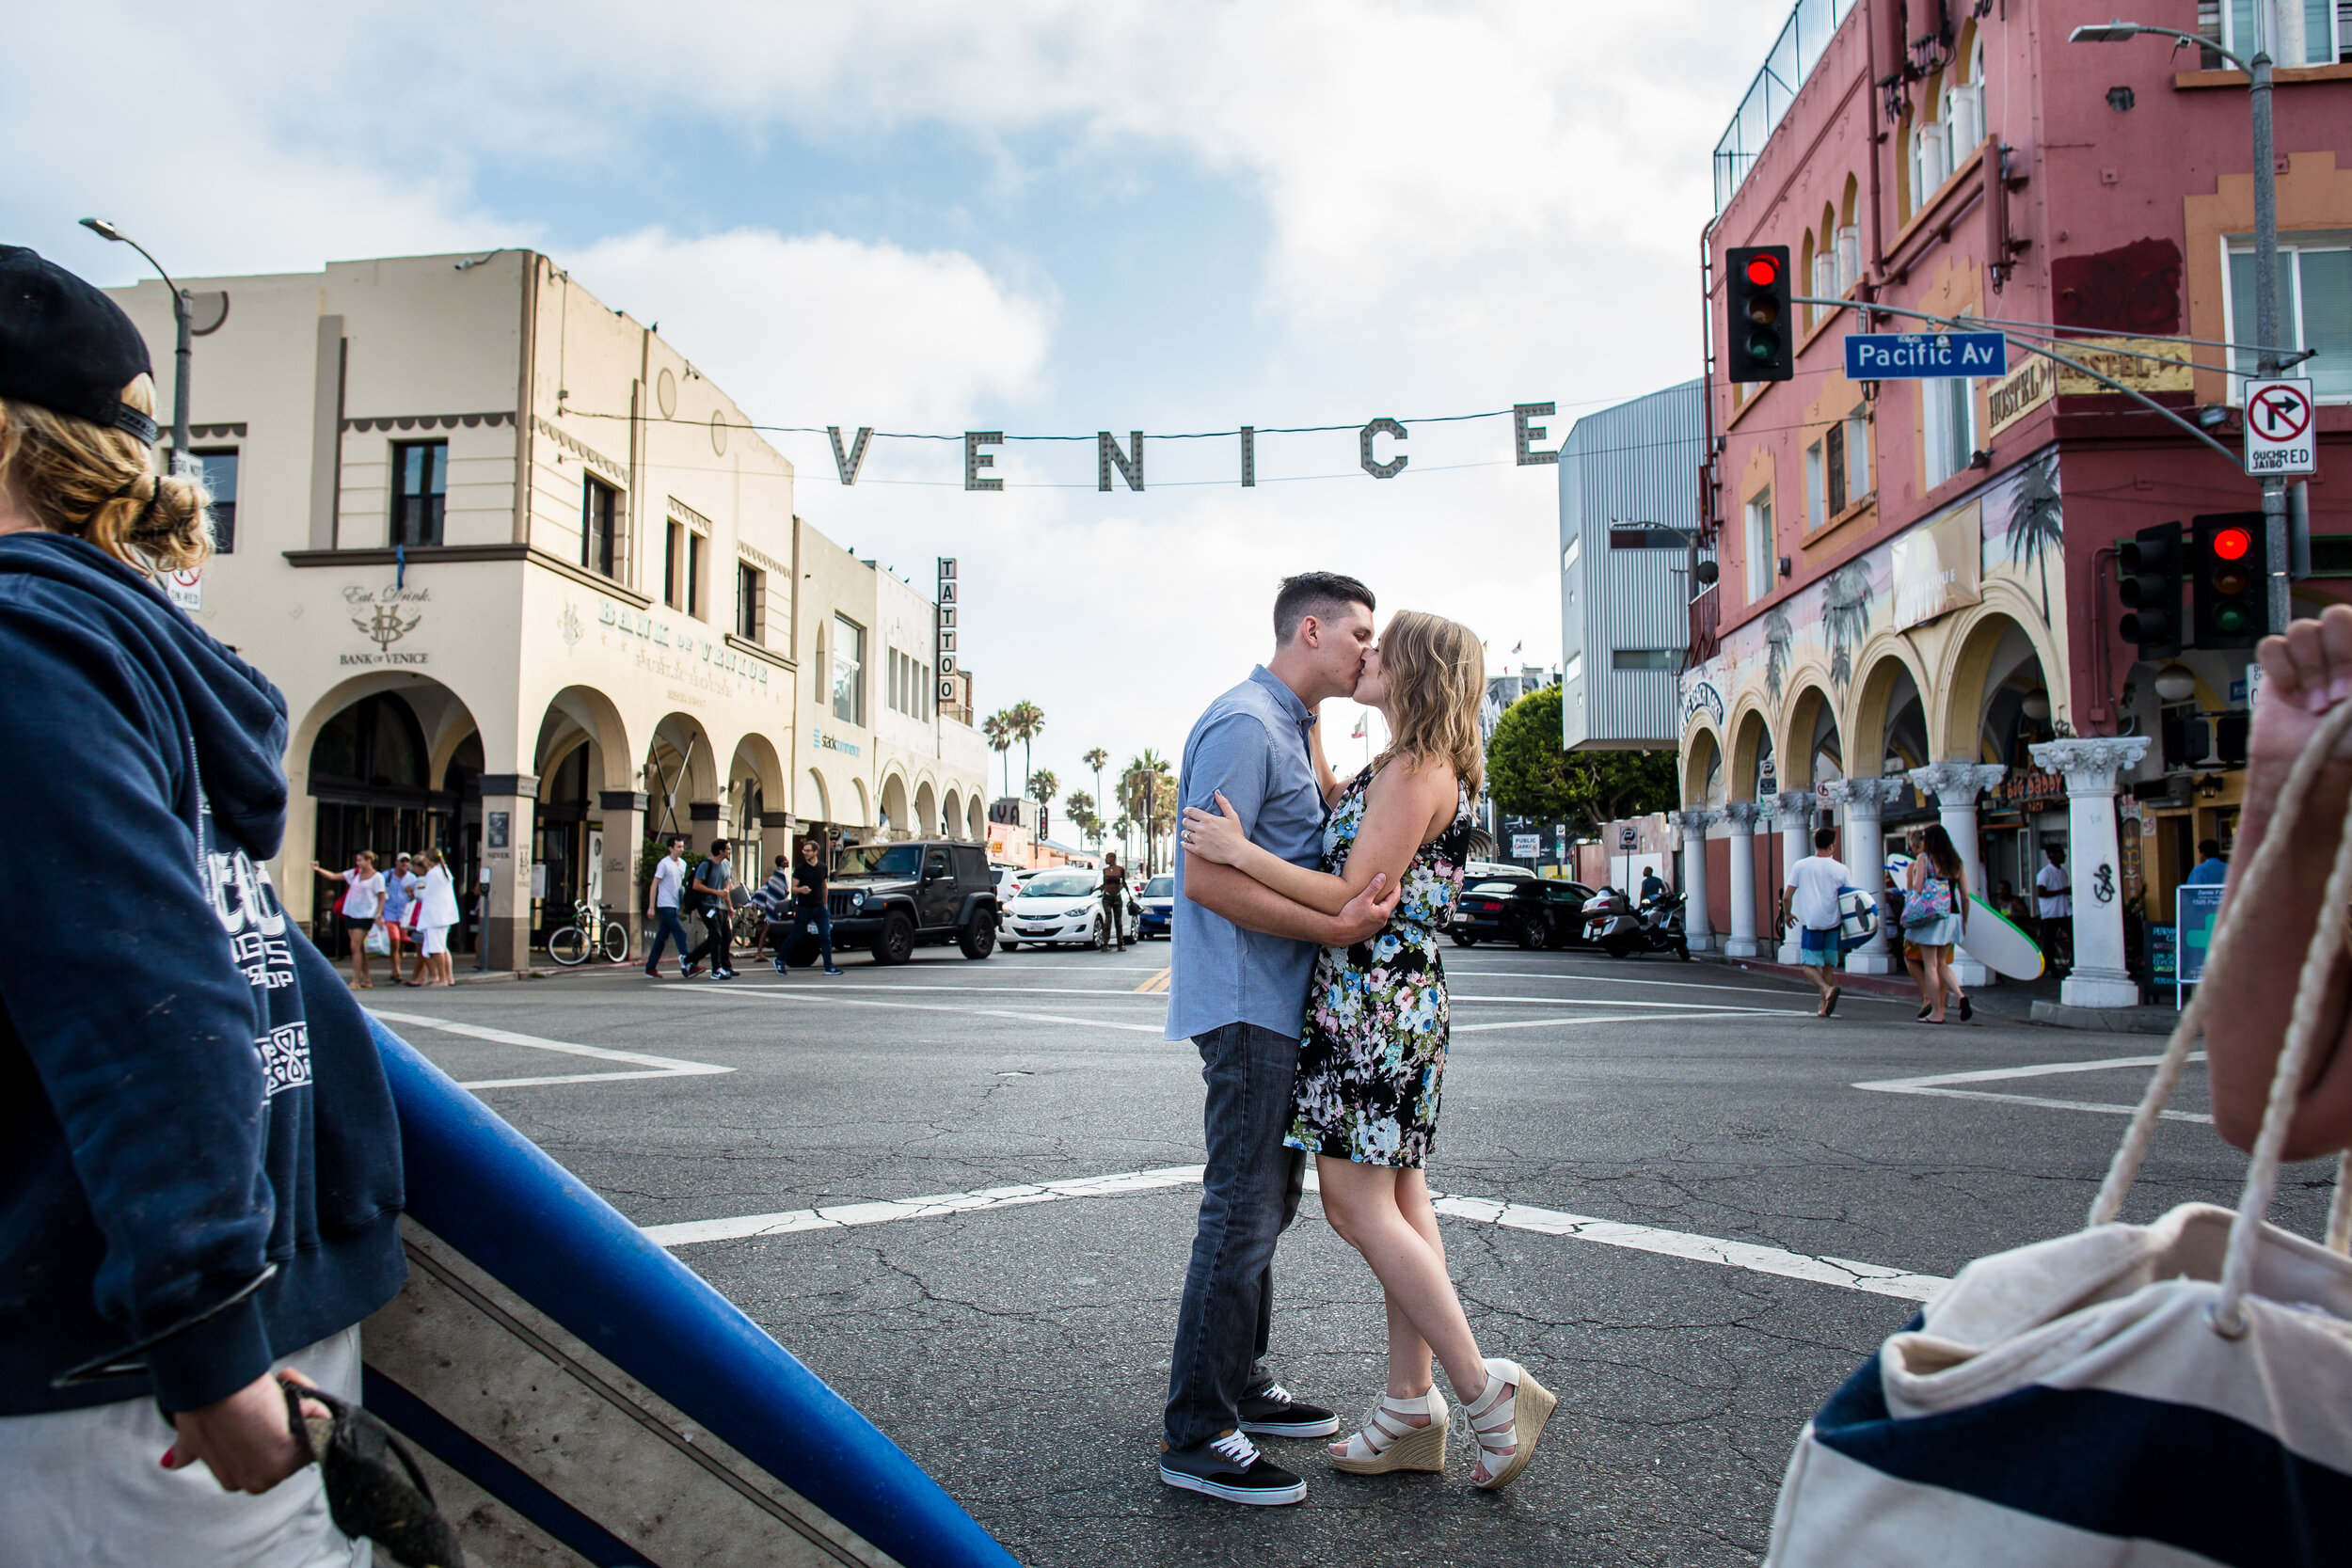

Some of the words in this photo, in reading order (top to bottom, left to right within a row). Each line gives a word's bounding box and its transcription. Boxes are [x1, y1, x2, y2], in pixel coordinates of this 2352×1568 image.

[1858, 341, 1952, 367] Pacific
[1962, 341, 1994, 365] Av
[1989, 363, 2040, 429] HOSTEL
[826, 402, 1559, 491] VENICE
[340, 654, 373, 665] BANK
[385, 653, 429, 664] VENICE
[598, 598, 670, 647] BANK
[699, 640, 768, 684] VENICE
[941, 561, 953, 697] TATTOO
